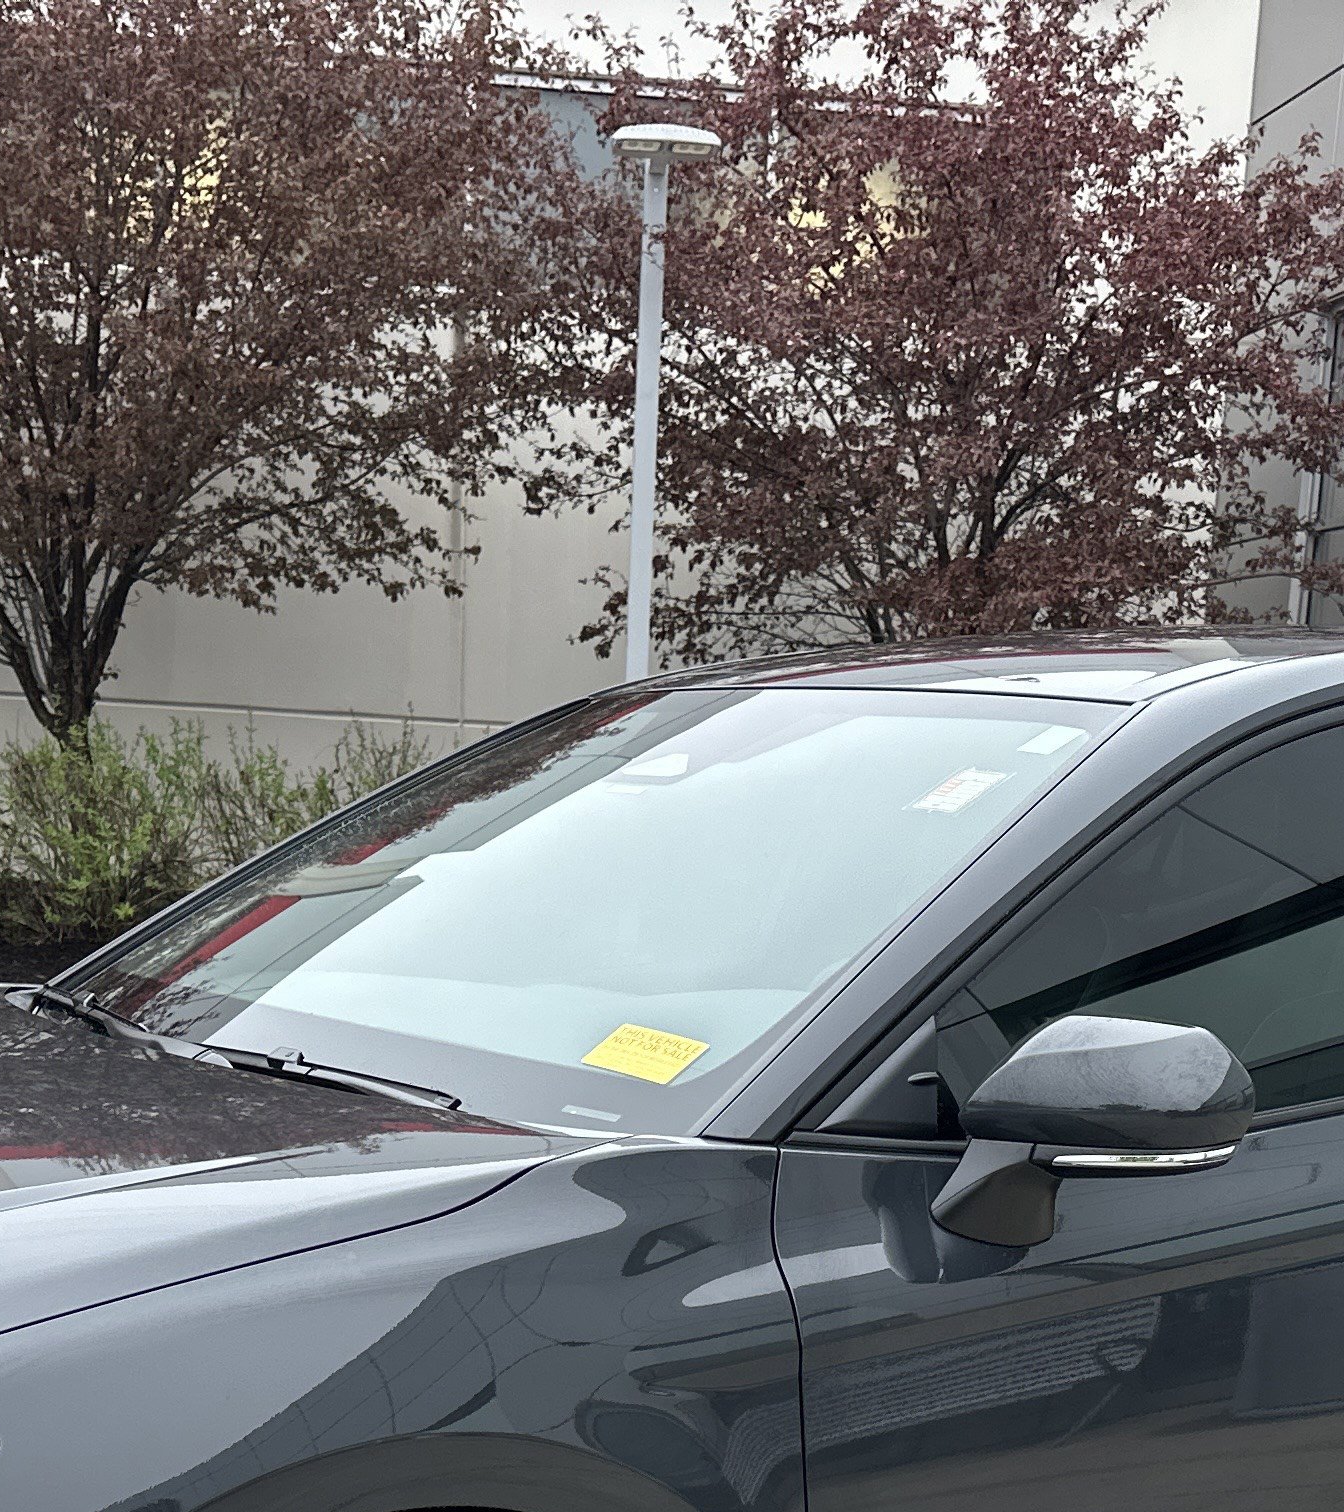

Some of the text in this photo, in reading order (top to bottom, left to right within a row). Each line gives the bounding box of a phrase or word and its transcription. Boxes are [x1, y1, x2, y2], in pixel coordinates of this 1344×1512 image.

[611, 1035, 692, 1062] NOT FOR SALE
[621, 1027, 701, 1055] THIS VEHICLE
